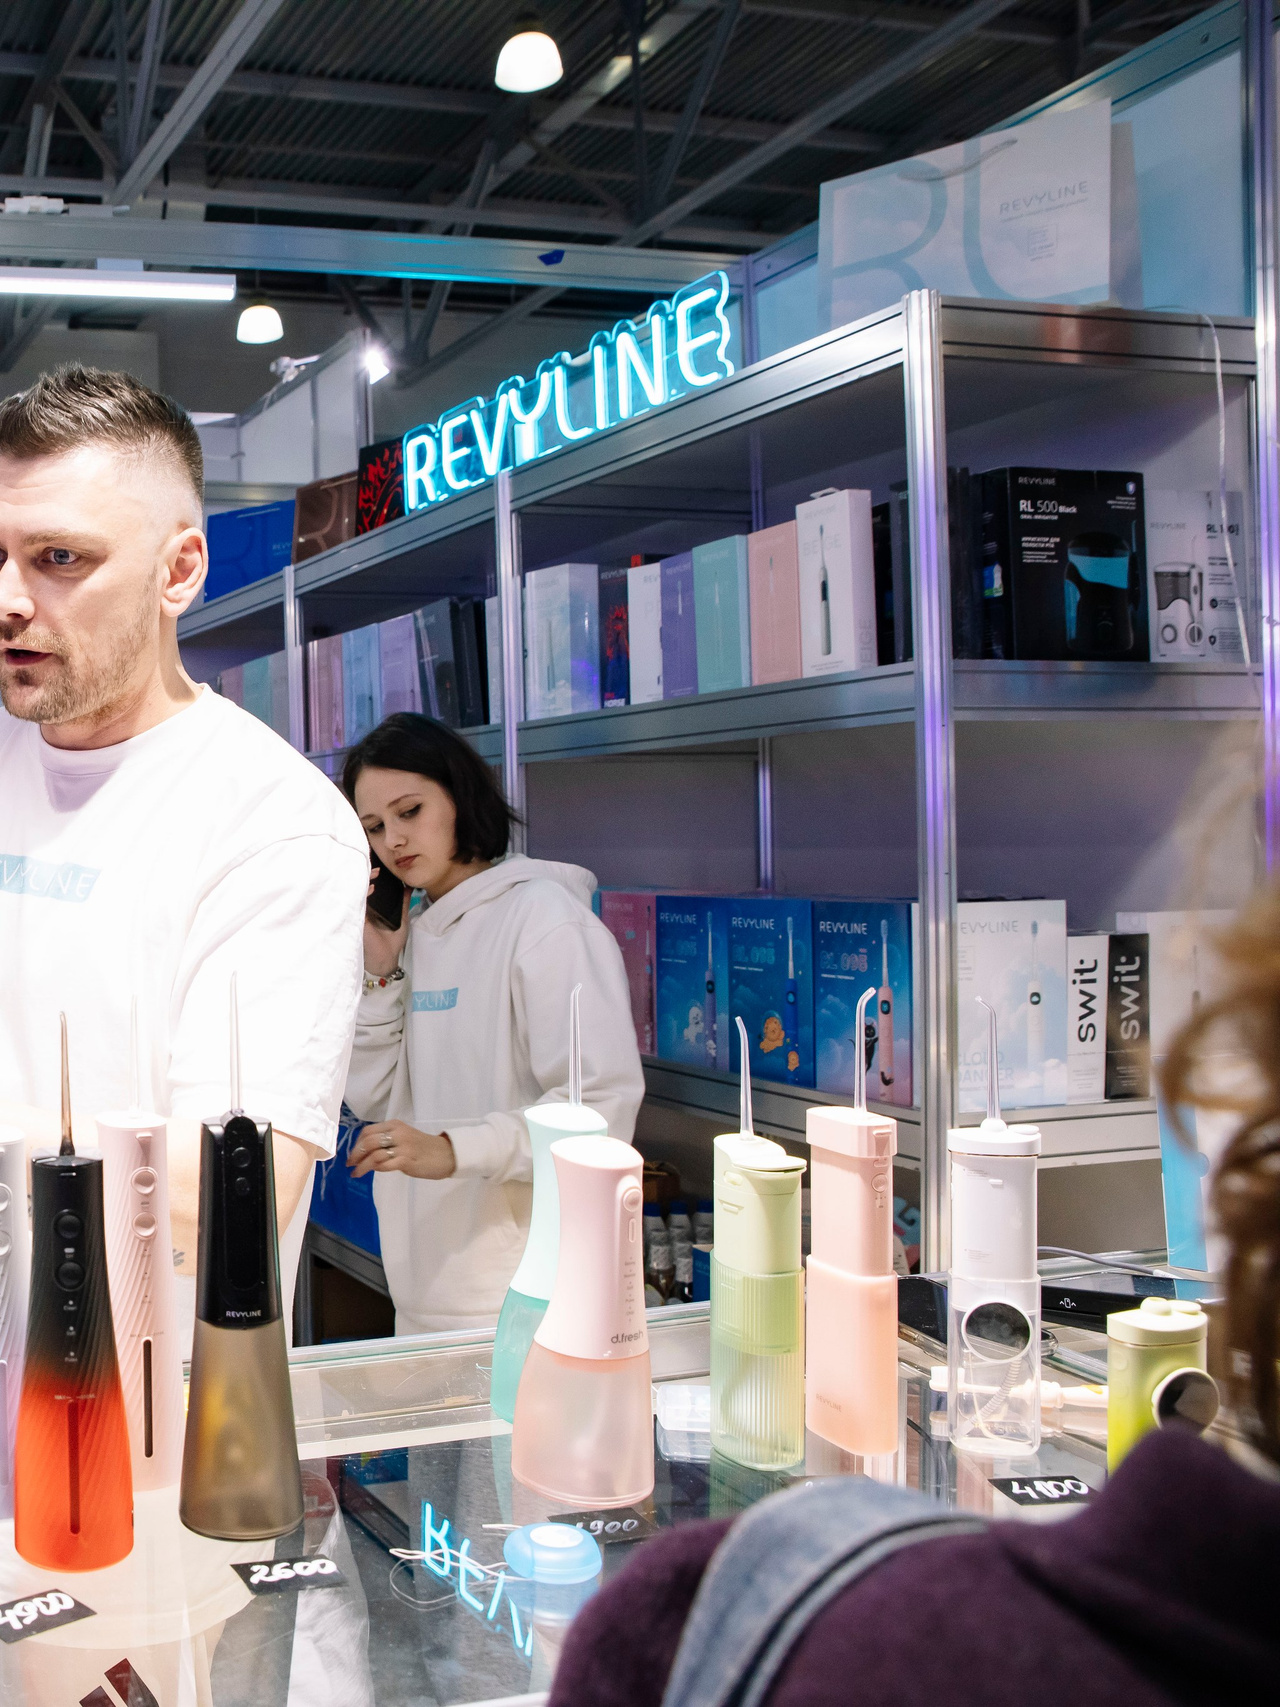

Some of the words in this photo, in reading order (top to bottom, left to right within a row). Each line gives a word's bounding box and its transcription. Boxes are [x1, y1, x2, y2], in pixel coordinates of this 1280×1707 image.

[999, 181, 1088, 215] REVYLINE
[406, 287, 720, 511] REVYLINE
[1019, 500, 1035, 512] RL
[1037, 500, 1058, 513] 500
[660, 912, 697, 925] REVYLINE
[731, 917, 775, 930] REVYLINE
[819, 921, 868, 935] REVYLINE
[225, 1310, 262, 1318] REVYLINE
[610, 1330, 644, 1344] d.fresh
[250, 1559, 338, 1585] 2600
